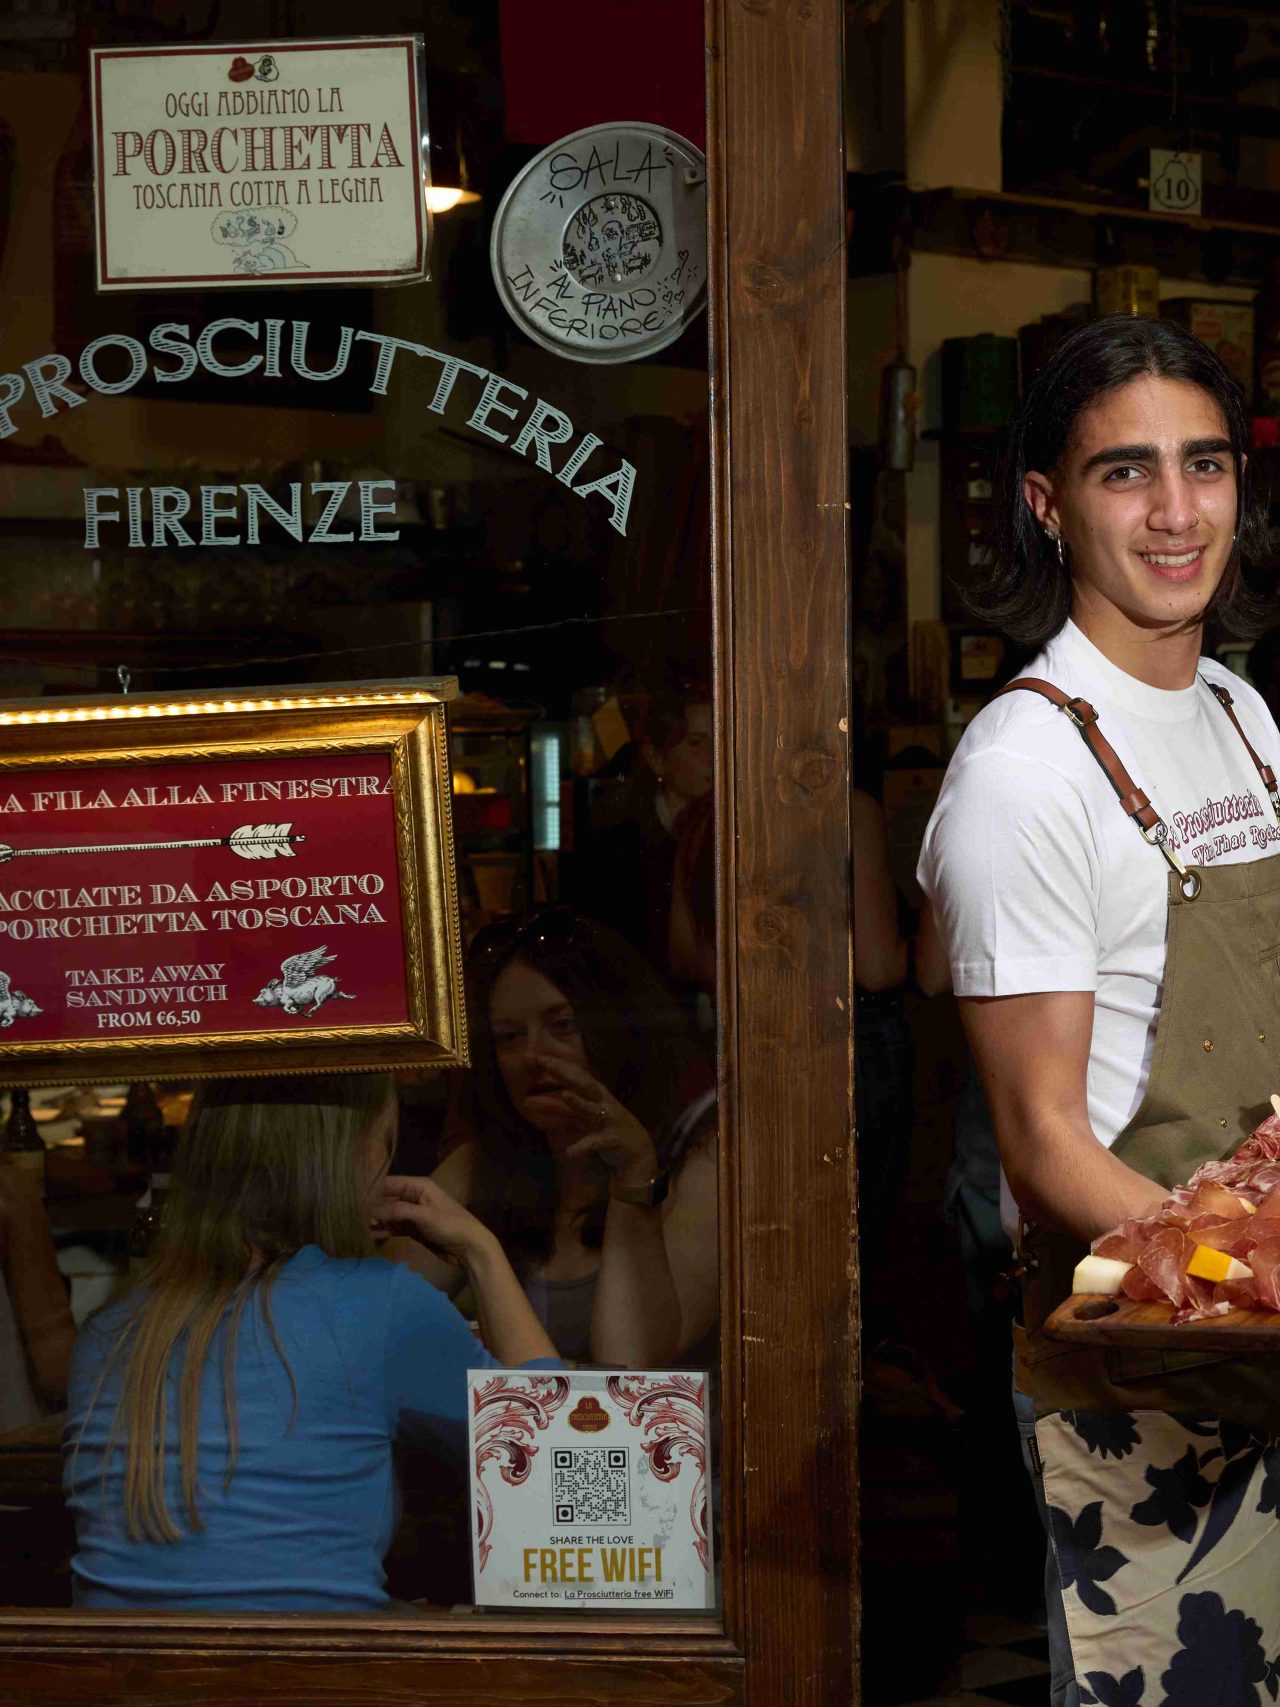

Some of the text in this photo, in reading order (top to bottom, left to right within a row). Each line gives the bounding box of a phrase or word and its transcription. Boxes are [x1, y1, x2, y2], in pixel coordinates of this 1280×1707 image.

[165, 87, 344, 118] OGGI ABBIAMO LA
[111, 122, 405, 176] PORCHETTA
[549, 140, 667, 194] SALA
[133, 177, 384, 210] TOSCANA COTTA A LEGNA
[1165, 178, 1190, 201] 10
[507, 263, 665, 340] INFERIORE
[546, 272, 657, 320] AL PIANO
[0, 317, 637, 537] PROSCIUTTERIA
[82, 479, 401, 549] FIRENZE
[0, 793, 26, 814] A
[31, 788, 117, 813] FILA
[120, 784, 216, 808] ALLA
[1213, 830, 1247, 858] That
[149, 882, 201, 905] DA
[205, 873, 385, 902] ASPORTO
[212, 902, 387, 931] TOSCANA
[65, 963, 226, 988] TAKE AWAY
[66, 984, 228, 1009] SANDWICH
[97, 1008, 201, 1029] FROM €6,50
[550, 1535, 634, 1545] SHARE THE LOVE
[523, 1548, 662, 1583] FREE WIFI
[513, 1589, 673, 1598] Connect to: La Prosciutteria free WiFi
